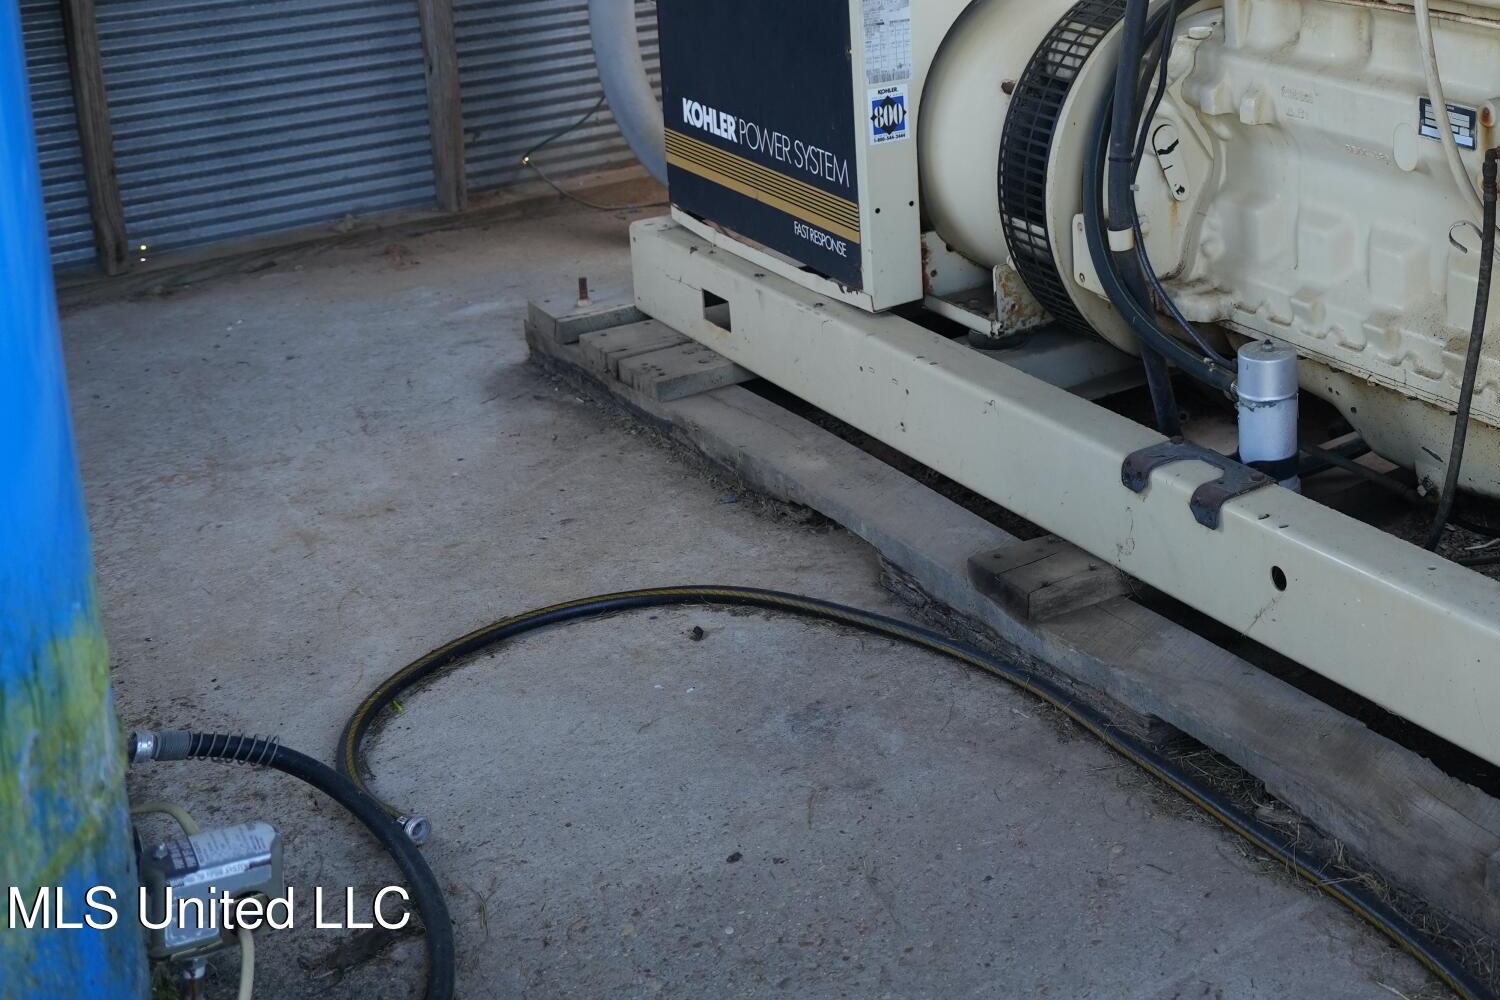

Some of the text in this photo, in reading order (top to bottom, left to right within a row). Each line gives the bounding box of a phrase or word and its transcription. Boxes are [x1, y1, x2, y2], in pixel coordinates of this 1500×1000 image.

[878, 87, 898, 95] KOHLER
[873, 103, 904, 128] 800
[682, 97, 850, 188] KOHLER POWER SYSTEM
[793, 220, 847, 258] FAST RESPONSE
